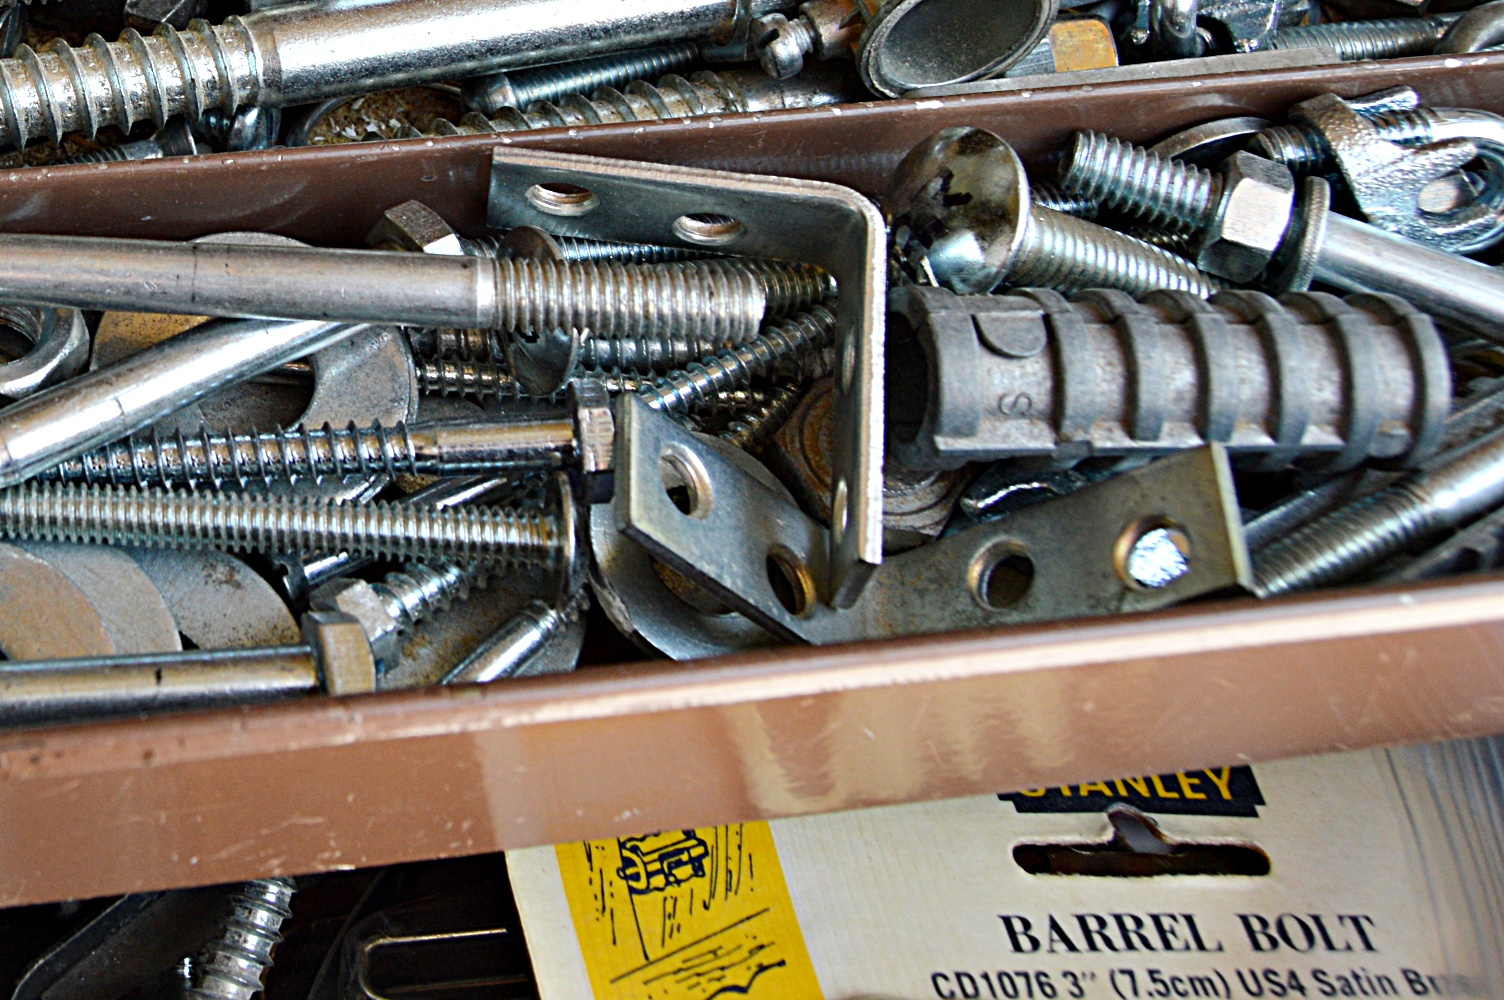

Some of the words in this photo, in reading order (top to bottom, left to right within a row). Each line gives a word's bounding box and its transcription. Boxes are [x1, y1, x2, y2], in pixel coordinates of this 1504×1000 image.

[1018, 766, 1214, 800] NLEY
[996, 912, 1224, 953] BARREL
[1234, 912, 1378, 953] BOLT
[930, 969, 1058, 1000] CD1076
[1108, 966, 1231, 1000] (7.5cm)
[1236, 967, 1307, 998] US4
[1311, 965, 1399, 997] Satin
